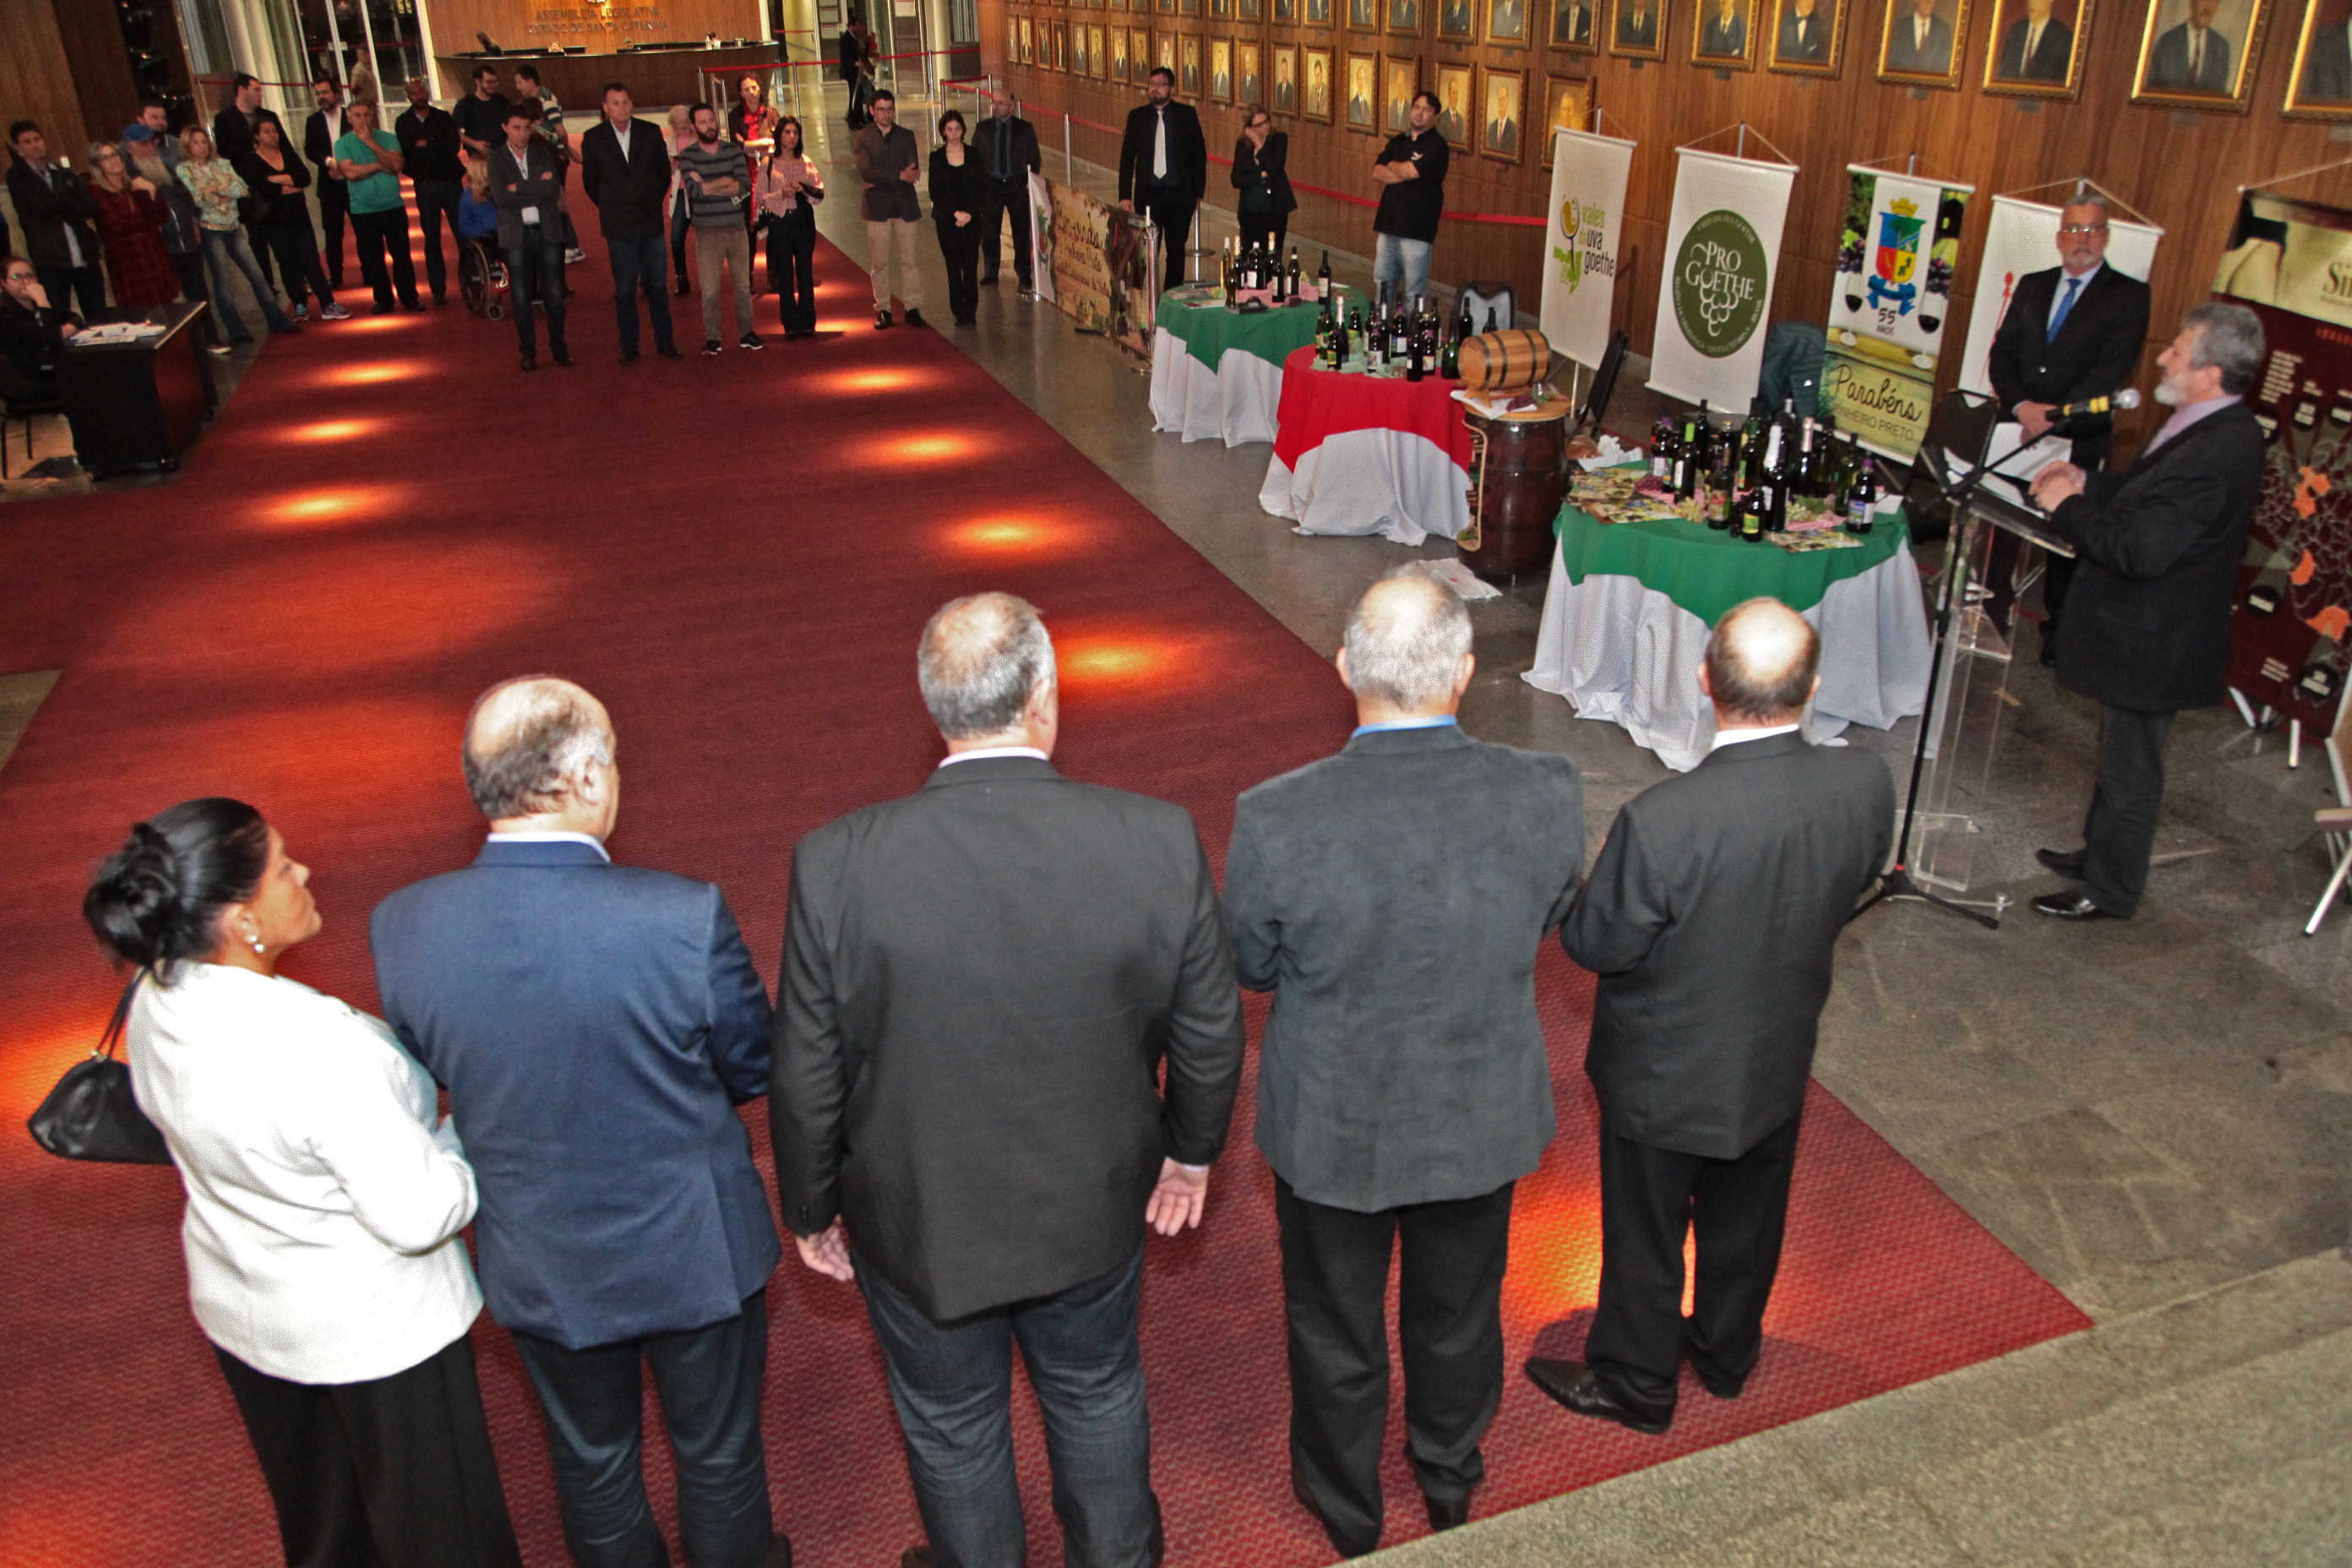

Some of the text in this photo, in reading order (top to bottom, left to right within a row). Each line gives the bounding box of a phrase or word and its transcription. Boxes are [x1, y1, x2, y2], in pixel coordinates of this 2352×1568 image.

[1582, 203, 1605, 229] vales
[1587, 229, 1603, 250] uva
[1584, 251, 1614, 277] goethe
[1695, 241, 1741, 273] PRO
[1685, 260, 1756, 301] GOETHE
[1878, 308, 1897, 325] 55
[1835, 364, 1922, 422] Parabéns
[1833, 401, 1914, 442] PINHEIRO PRETO
